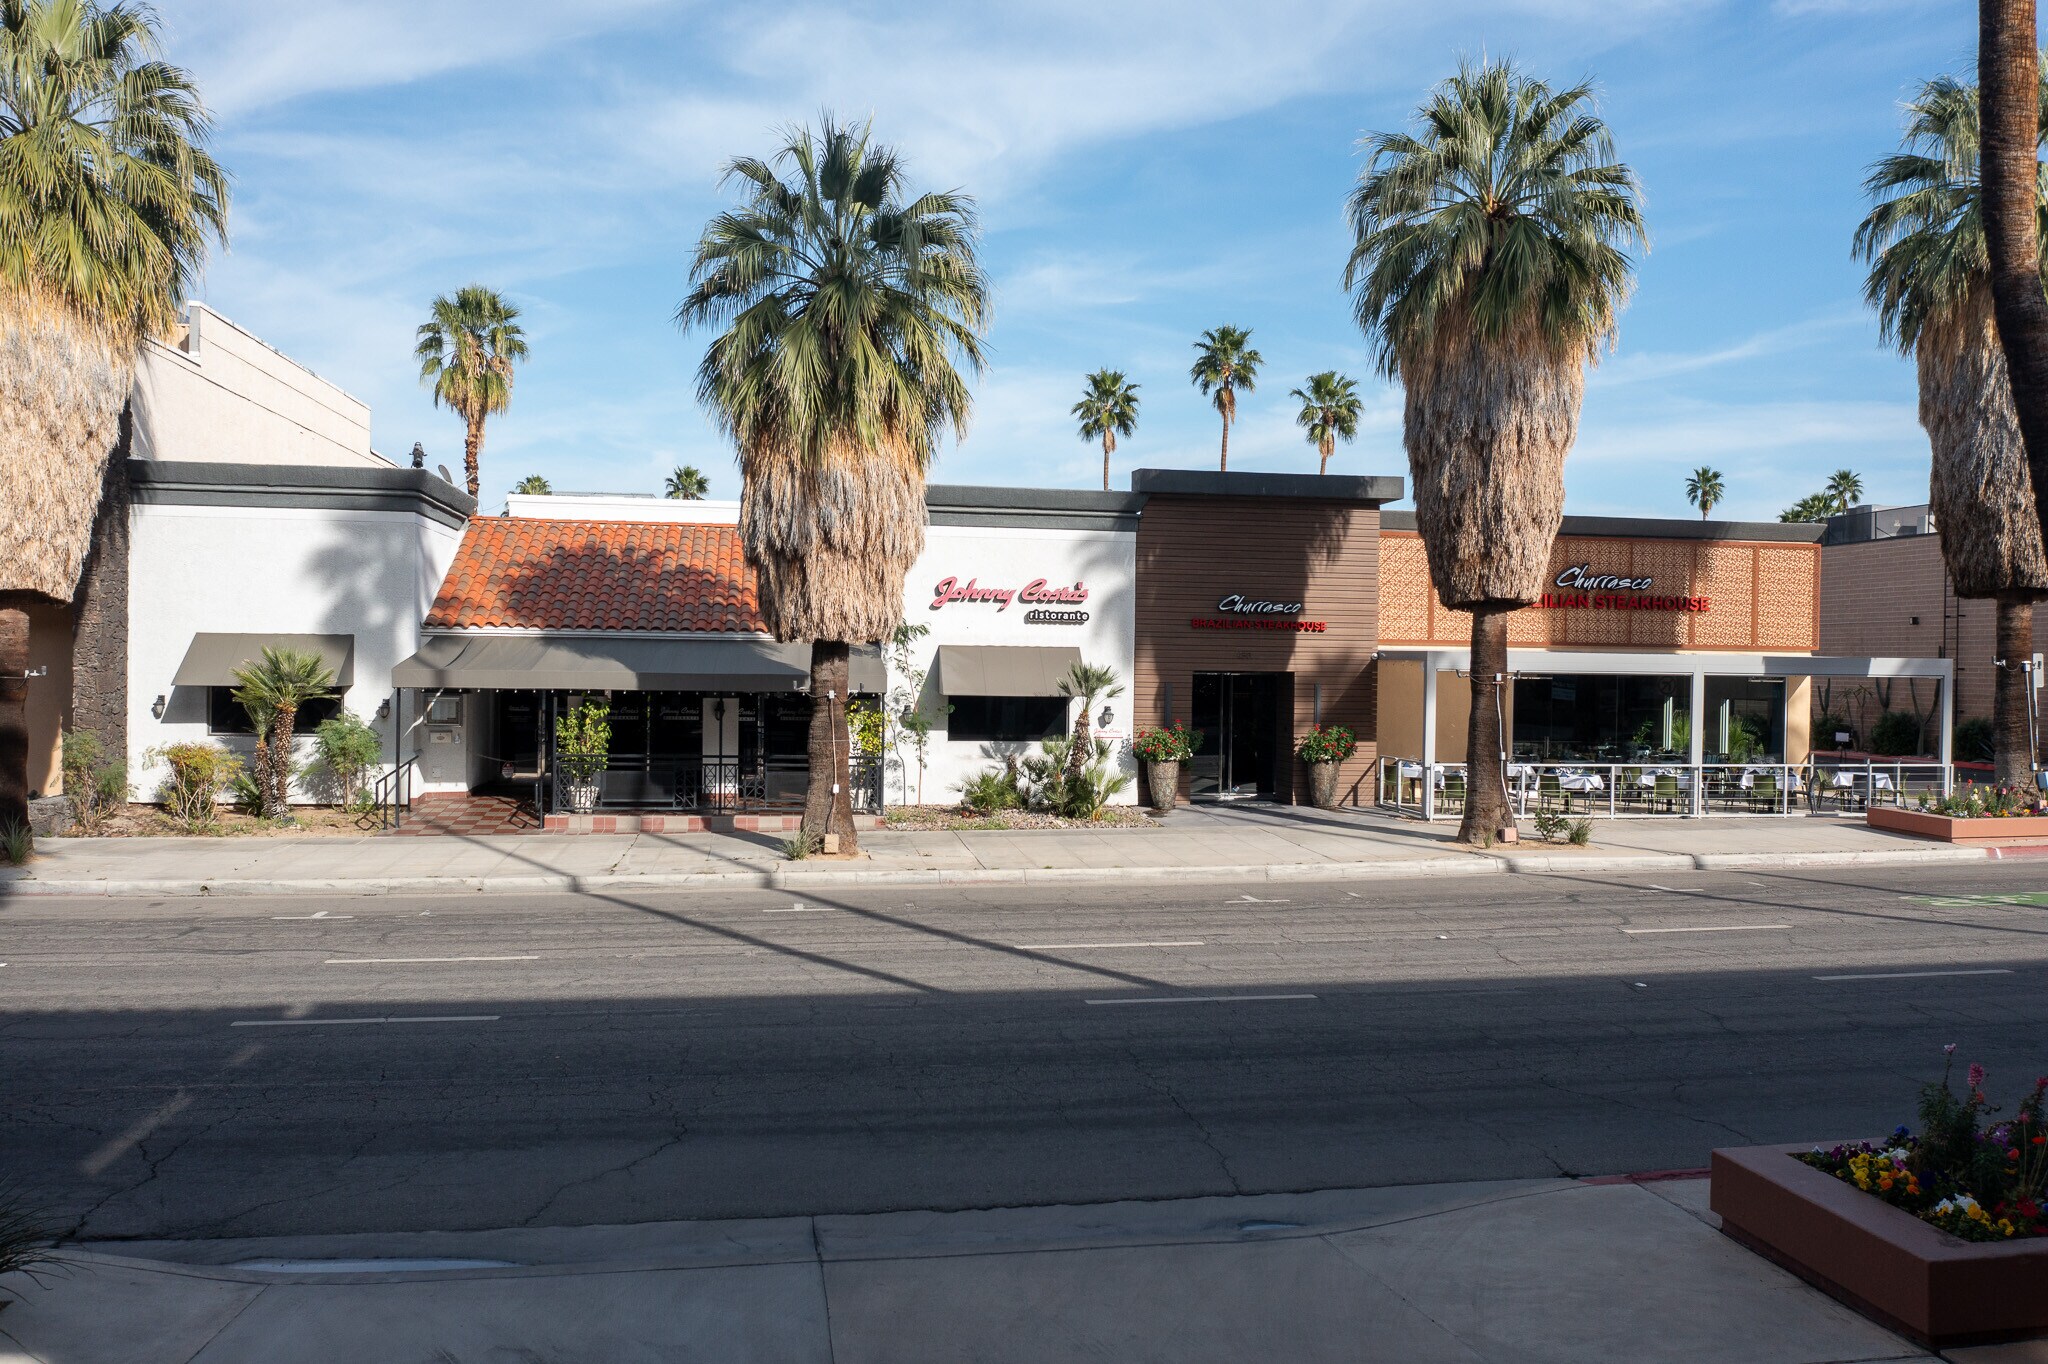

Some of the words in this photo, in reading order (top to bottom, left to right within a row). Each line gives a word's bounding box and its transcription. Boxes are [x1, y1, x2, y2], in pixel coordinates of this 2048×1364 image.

[1555, 563, 1654, 590] Churrasco
[931, 576, 1017, 611] Johnny
[1018, 578, 1089, 603] Costa's
[1217, 594, 1302, 614] Churrasco
[1593, 595, 1711, 612] STEAKHOUSE
[1028, 610, 1090, 622] ristorante
[1191, 618, 1251, 630] BRAZILIAN
[1254, 618, 1328, 632] STEAKHOUSE
